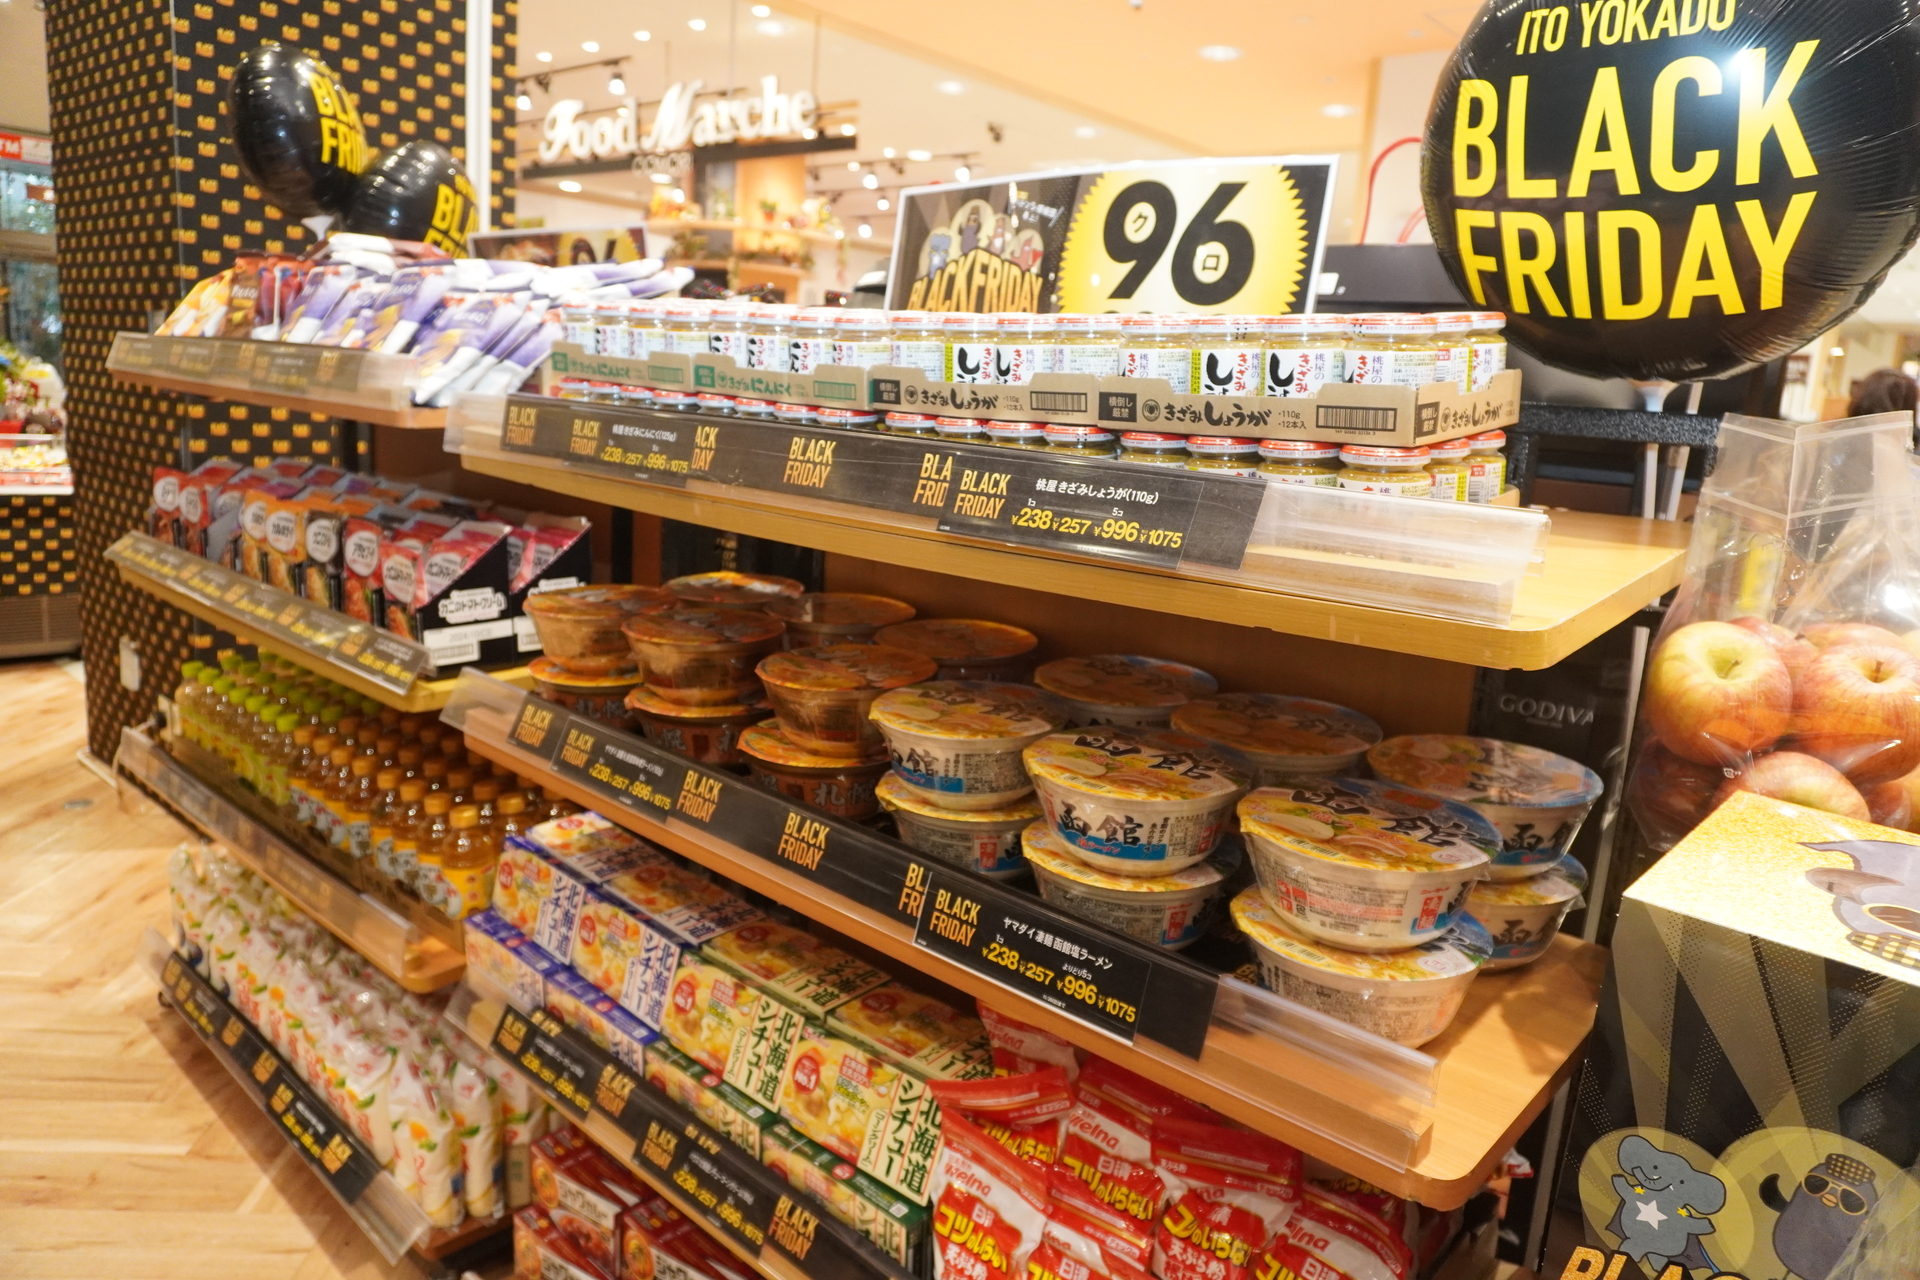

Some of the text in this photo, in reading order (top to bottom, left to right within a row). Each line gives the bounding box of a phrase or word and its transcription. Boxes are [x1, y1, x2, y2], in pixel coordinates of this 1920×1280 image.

[1515, 0, 1737, 56] ITO YOKADO
[539, 75, 818, 162] Food Marche
[1452, 39, 1820, 200] BLACK
[1104, 180, 1255, 306] 96
[1455, 191, 1817, 321] FRIDAY
[1234, 352, 1250, 391] きざみ
[1295, 352, 1314, 393] きざみ
[1314, 353, 1325, 380] 桃屋の
[1371, 356, 1384, 384] 桃屋の
[920, 387, 1000, 410] きざみしょうが
[1108, 395, 1134, 408] 横倒し
[1111, 407, 1131, 419] 厳禁
[1163, 400, 1273, 427] きざみしょうが
[508, 406, 537, 426] BLACK
[572, 419, 600, 438] BLACK
[1451, 402, 1503, 429] きざみしょうが
[506, 426, 535, 446] FRIDAY
[570, 437, 598, 456] FRIDAY
[789, 436, 836, 465] BLACK
[783, 460, 831, 488] FRIDAY
[920, 453, 953, 481] BLA
[959, 469, 1011, 496] BLACK
[953, 493, 1005, 520] FRIDAY
[1035, 478, 1159, 505] 桃屋 きざみしょうが(110g)
[1011, 508, 1183, 548] ¥238 ¥257 ¥996 ¥1075
[1112, 507, 1124, 517] 5コ
[522, 704, 553, 729] BLACK
[1501, 694, 1594, 727] GODIVA
[515, 723, 546, 748] FRIDAY
[566, 729, 595, 752] BLACK
[560, 745, 590, 768] FRIDAY
[682, 770, 723, 804] BLACK
[677, 790, 718, 823] FRIDAY
[784, 811, 829, 849] BLACK
[1058, 800, 1144, 848] 函館
[777, 834, 824, 871] FRIDAY
[935, 889, 981, 926] BLACK
[929, 911, 976, 947] FRIDAY
[637, 933, 658, 1012] シチュー
[651, 944, 675, 1027] 北海道
[981, 943, 1137, 1024] ¥238 ¥257 ¥996 ¥1075
[746, 1000, 776, 1089] シチュー
[757, 1012, 798, 1103] 北海道
[794, 1071, 817, 1090] No.1
[647, 1120, 679, 1151] BLACK
[886, 1079, 923, 1179] シチュー
[1068, 1112, 1121, 1151] Welna
[641, 1139, 673, 1171] FRIDAY
[901, 1098, 941, 1197] 北海道
[945, 1163, 992, 1198] Welna
[774, 1193, 820, 1240] BLACK
[768, 1216, 813, 1260] FRIDAY
